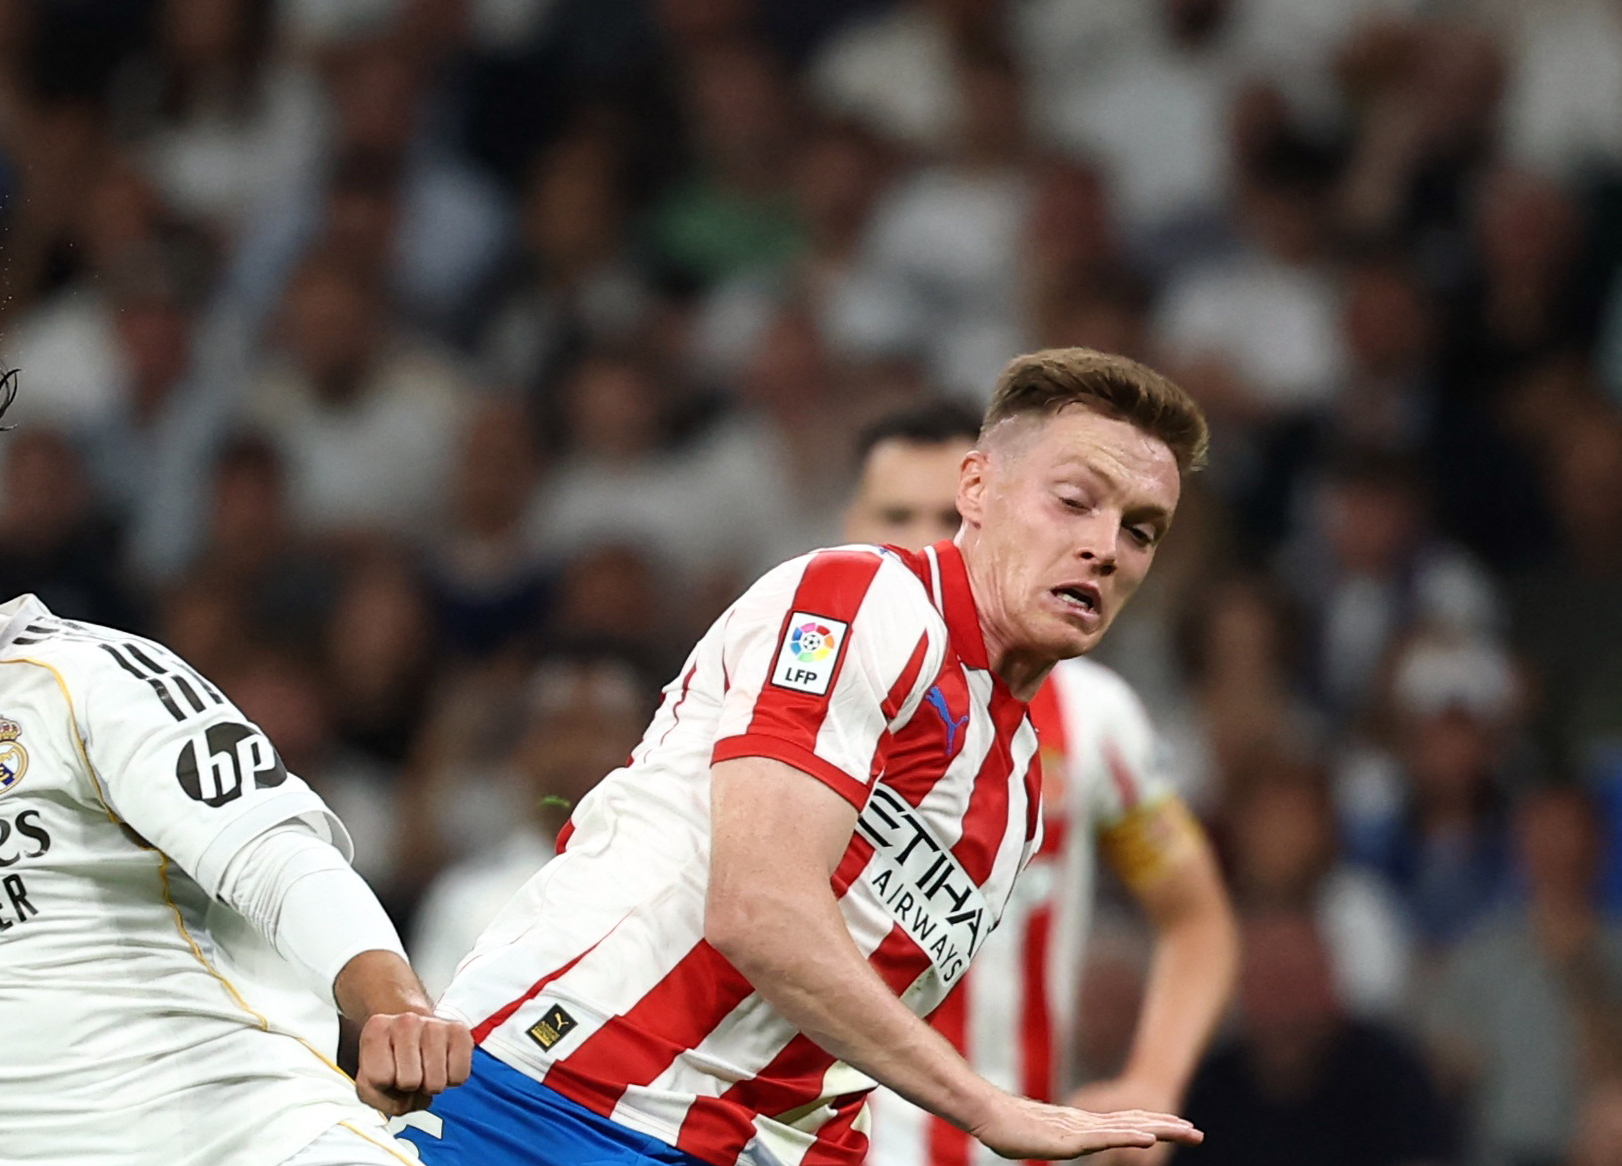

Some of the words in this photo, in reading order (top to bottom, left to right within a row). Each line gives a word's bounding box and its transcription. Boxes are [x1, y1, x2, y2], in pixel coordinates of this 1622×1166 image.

[785, 667, 818, 685] LFP
[189, 725, 278, 800] hp
[858, 788, 991, 959] ETIHA
[872, 869, 963, 983] AIRWAYS
